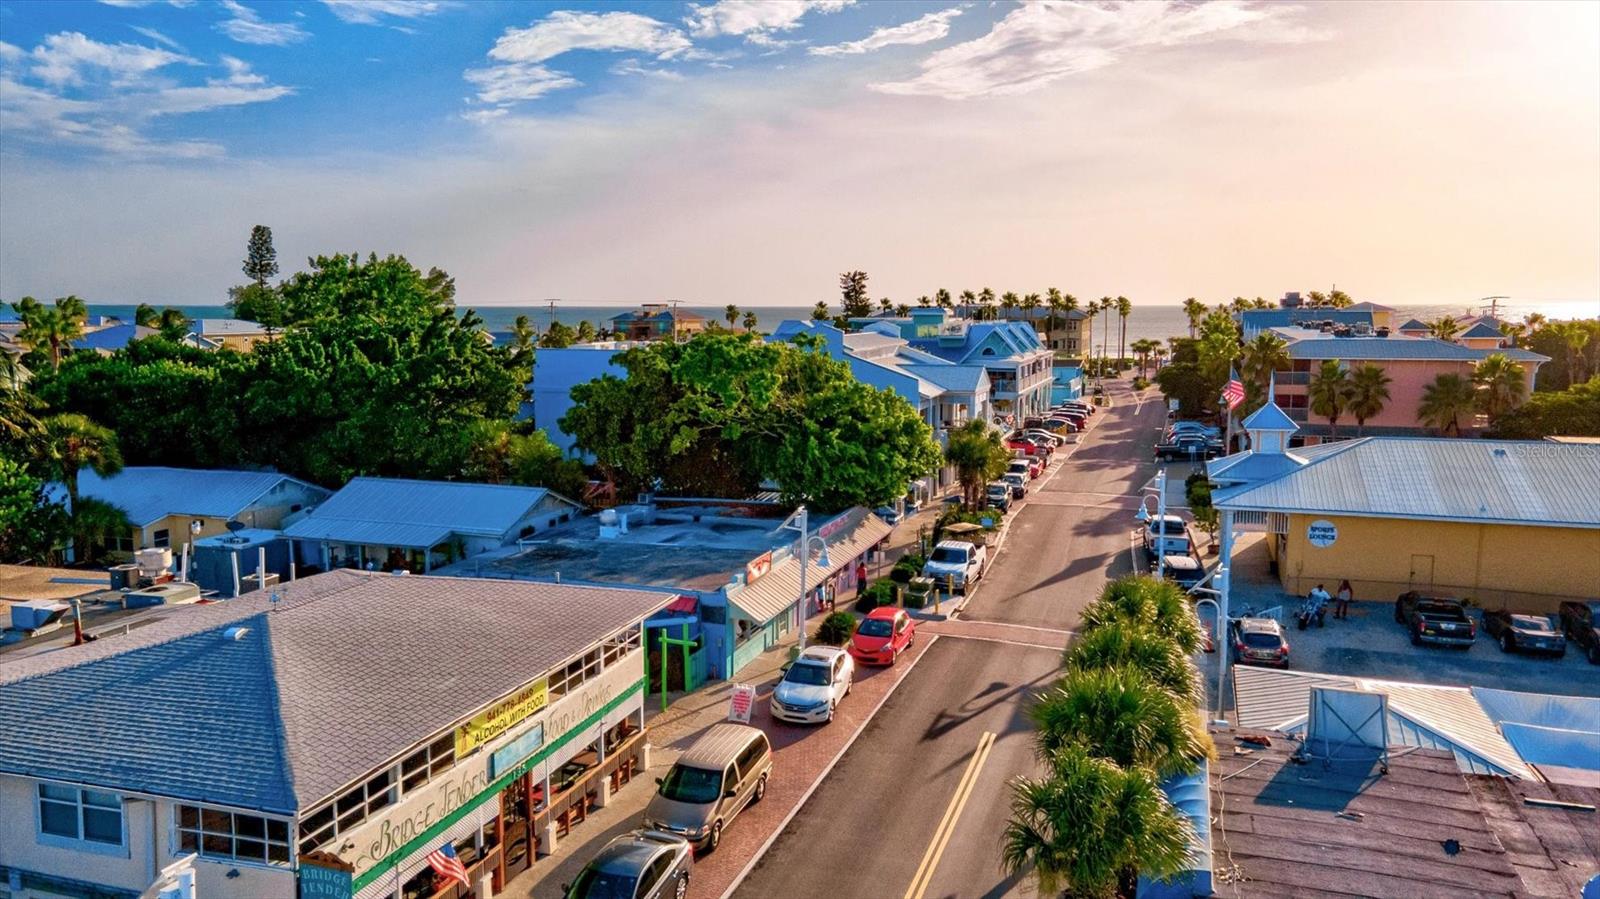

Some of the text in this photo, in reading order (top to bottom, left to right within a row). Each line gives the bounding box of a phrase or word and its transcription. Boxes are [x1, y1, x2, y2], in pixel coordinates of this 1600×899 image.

[474, 694, 544, 745] ALCOHOL WITH FOOD
[371, 770, 488, 861] BRIDGE TENDER
[301, 882, 350, 899] TENDER
[302, 868, 347, 886] BRIDGE
